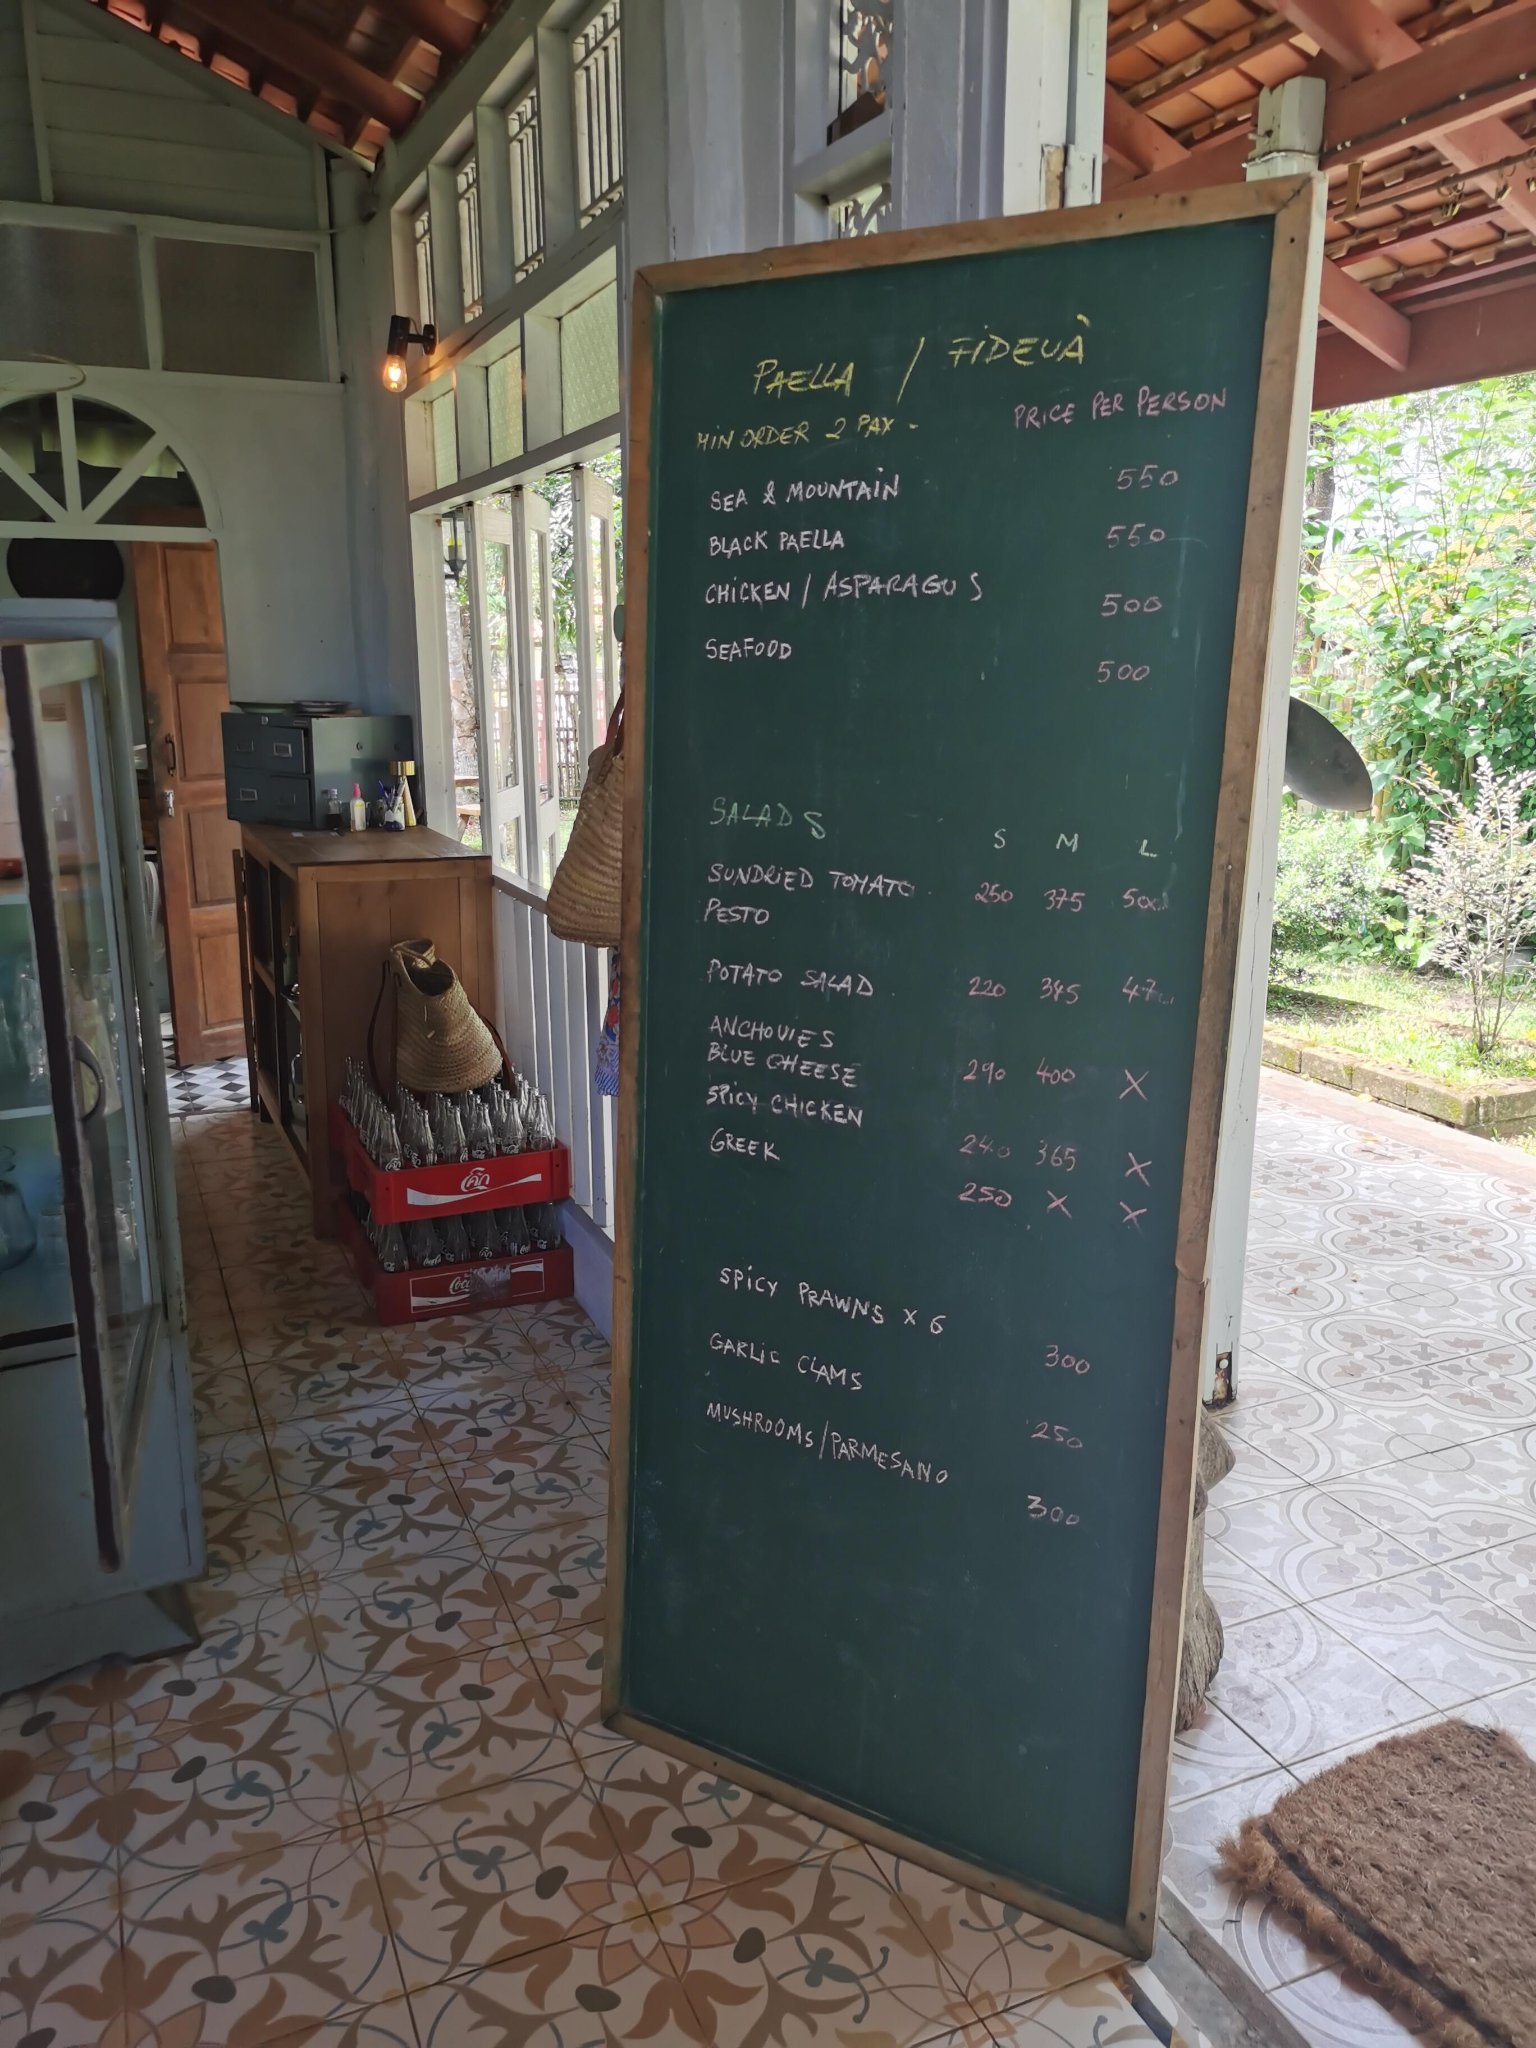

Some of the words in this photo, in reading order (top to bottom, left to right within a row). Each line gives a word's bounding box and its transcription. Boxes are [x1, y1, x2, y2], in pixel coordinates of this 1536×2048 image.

[754, 359, 854, 397] PAELLA
[1014, 402, 1076, 431] PRICE
[1092, 392, 1125, 421] PER
[1137, 386, 1227, 417] PERSON
[740, 421, 810, 448] ORDER
[826, 417, 845, 440] 2
[856, 416, 894, 438] PAX
[710, 490, 748, 512] SEA
[762, 480, 777, 505] &
[786, 468, 900, 502] MOUNTAIN
[1116, 464, 1179, 490] 550
[709, 531, 768, 559] BLACK
[779, 530, 846, 552] PAELLA
[1105, 525, 1167, 549] 550
[704, 576, 790, 605] CHICKEN
[823, 572, 984, 602] ASPARAGUS
[1101, 594, 1163, 617] 500
[705, 638, 792, 661] SEAFOOD
[1097, 661, 1151, 684] 500
[709, 796, 828, 840] SALADS
[993, 828, 1006, 850] S
[1056, 832, 1079, 853] M
[1138, 839, 1157, 857] L
[829, 870, 914, 899] TOMATO
[975, 882, 1013, 904] 250
[1044, 888, 1086, 913] 375
[703, 898, 770, 925] PESTO
[706, 959, 783, 987] POTATO
[800, 970, 873, 998] SALAD
[968, 976, 1006, 998] 220
[709, 1015, 834, 1048] ANCHOVIES
[707, 1043, 755, 1067] BLUE
[766, 1052, 857, 1088] CHEESE
[963, 1059, 1006, 1085] 290
[1036, 1057, 1076, 1085] 400
[706, 1082, 757, 1108] SPICY
[770, 1094, 863, 1128] CHICKEN
[709, 1126, 781, 1161] GREEK
[960, 1134, 1011, 1158] 240
[1036, 1140, 1077, 1172] 365
[958, 1183, 1013, 1208] 250
[719, 1265, 779, 1298] SPICY
[799, 1281, 885, 1325] PRAWNS
[930, 1315, 946, 1335] 6
[709, 1332, 780, 1365] GARLIC
[797, 1355, 863, 1391] CLAMS
[1044, 1344, 1090, 1375] 300
[1029, 1421, 1083, 1449] 250
[1027, 1494, 1080, 1525] 300
